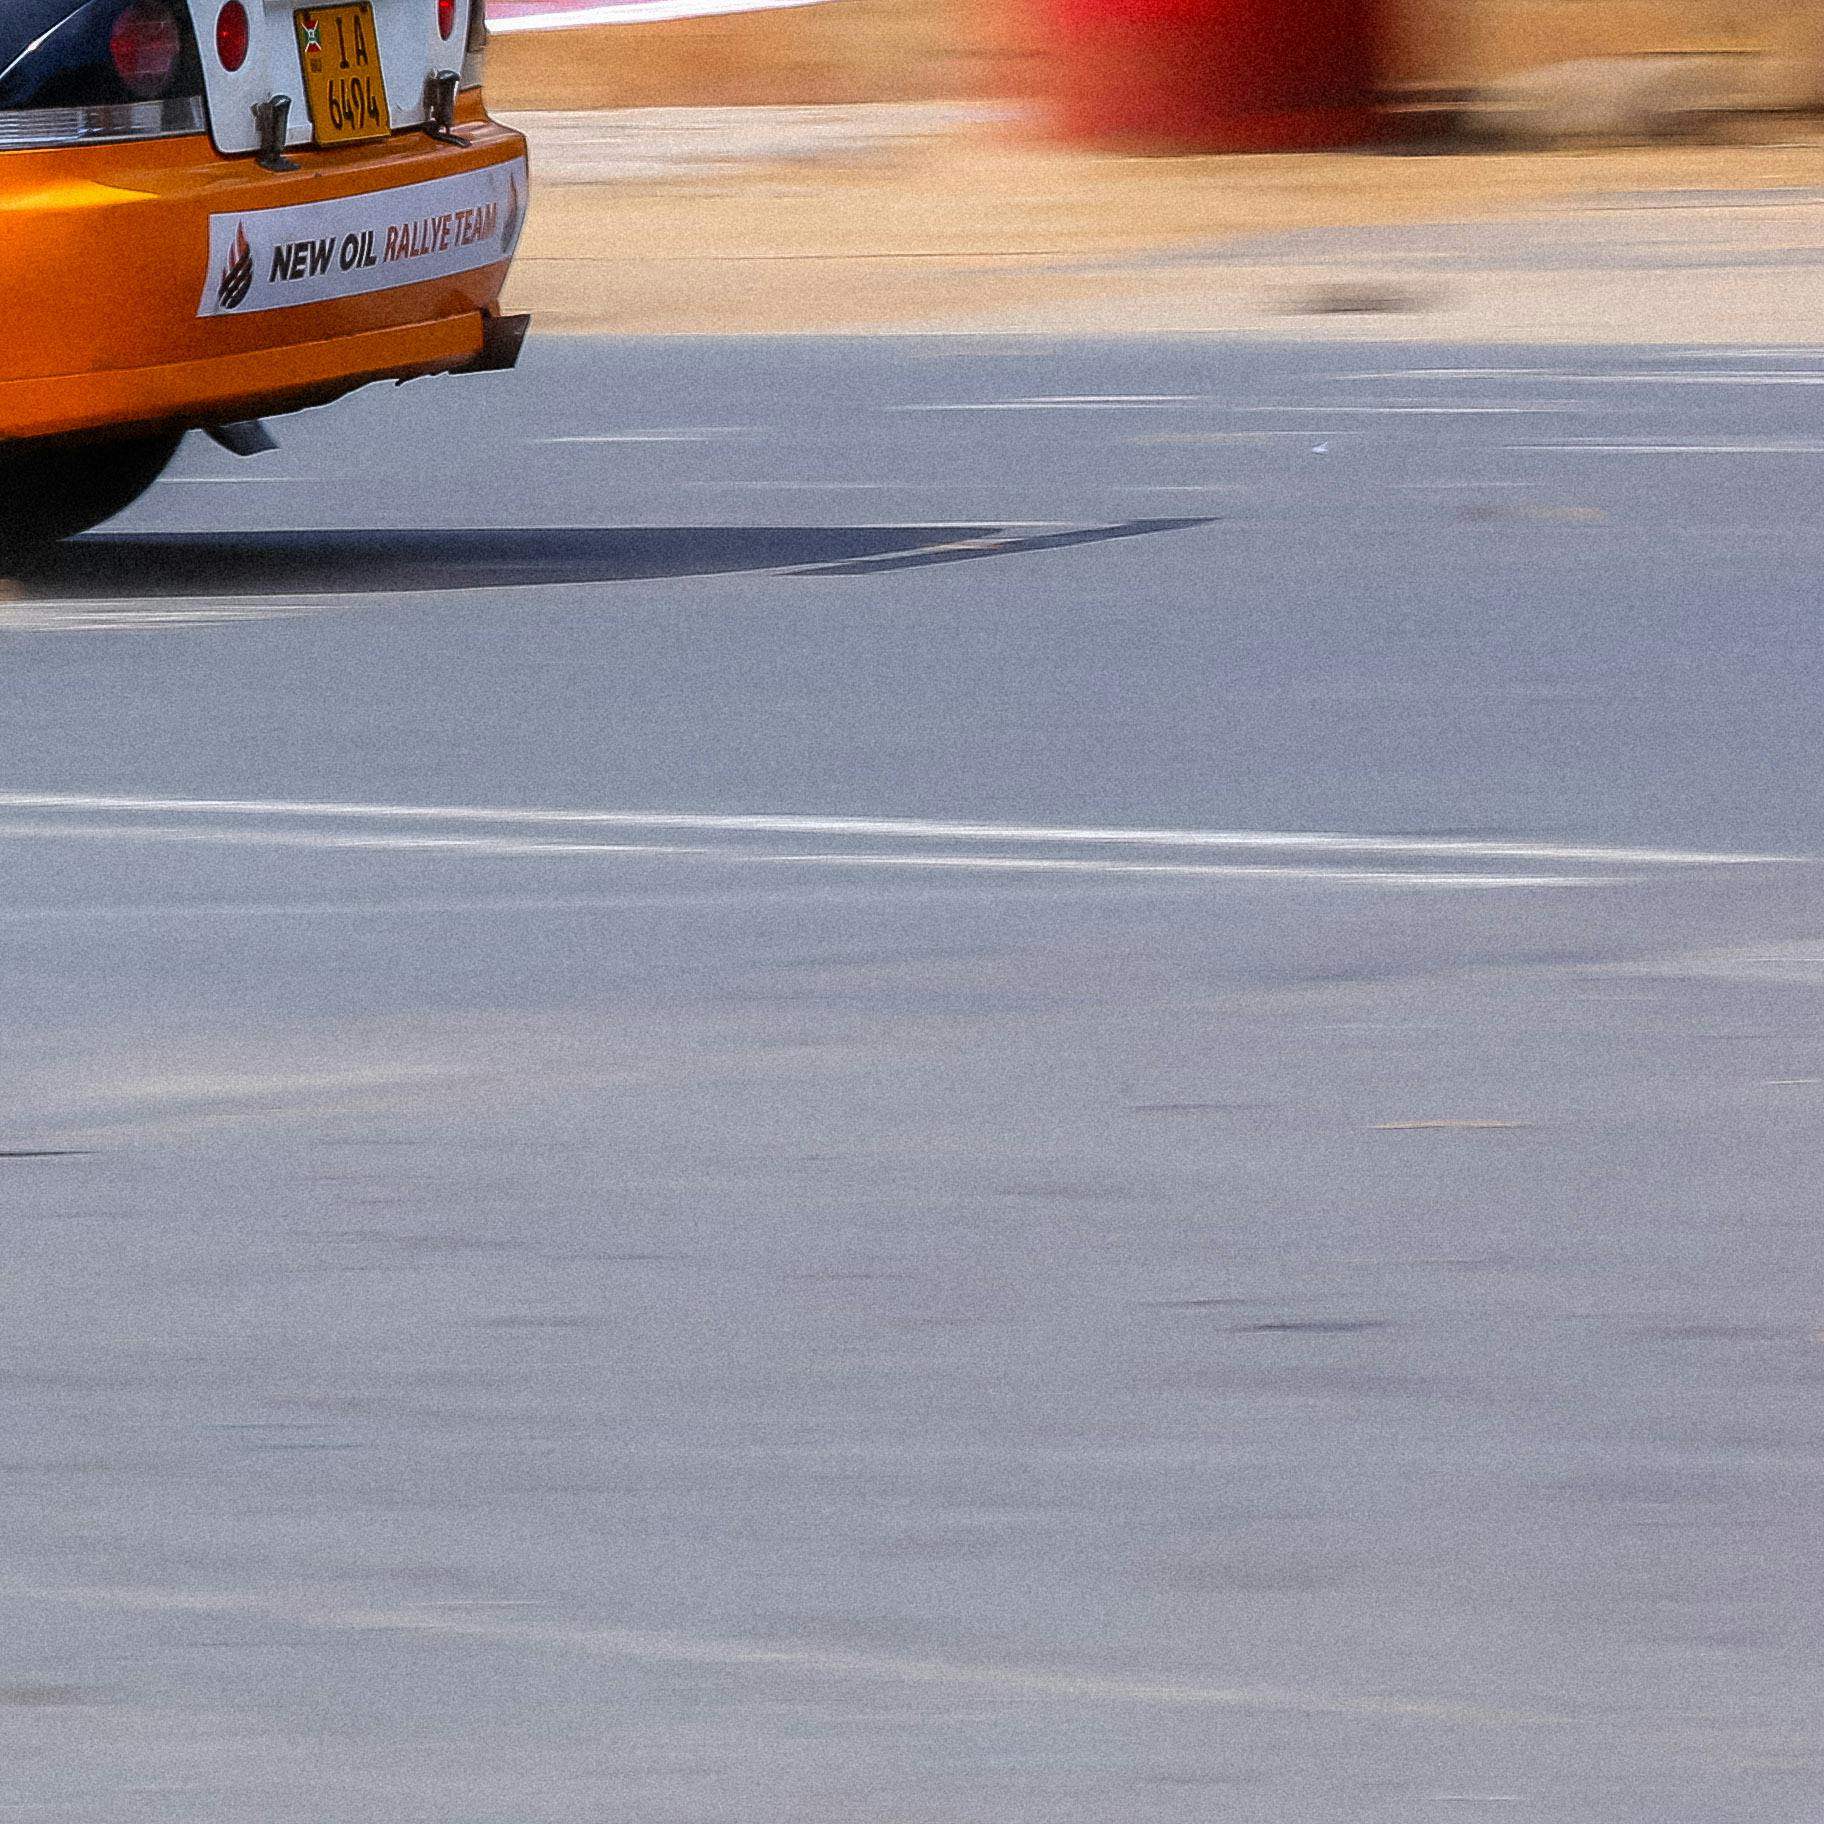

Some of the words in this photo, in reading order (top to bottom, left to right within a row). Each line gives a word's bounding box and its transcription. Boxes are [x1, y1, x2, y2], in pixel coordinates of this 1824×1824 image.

[329, 77, 380, 130] 6494
[269, 237, 336, 282] NEW
[339, 230, 377, 271] OIL
[383, 210, 453, 263] RALLYE
[453, 202, 499, 247] TEAM
